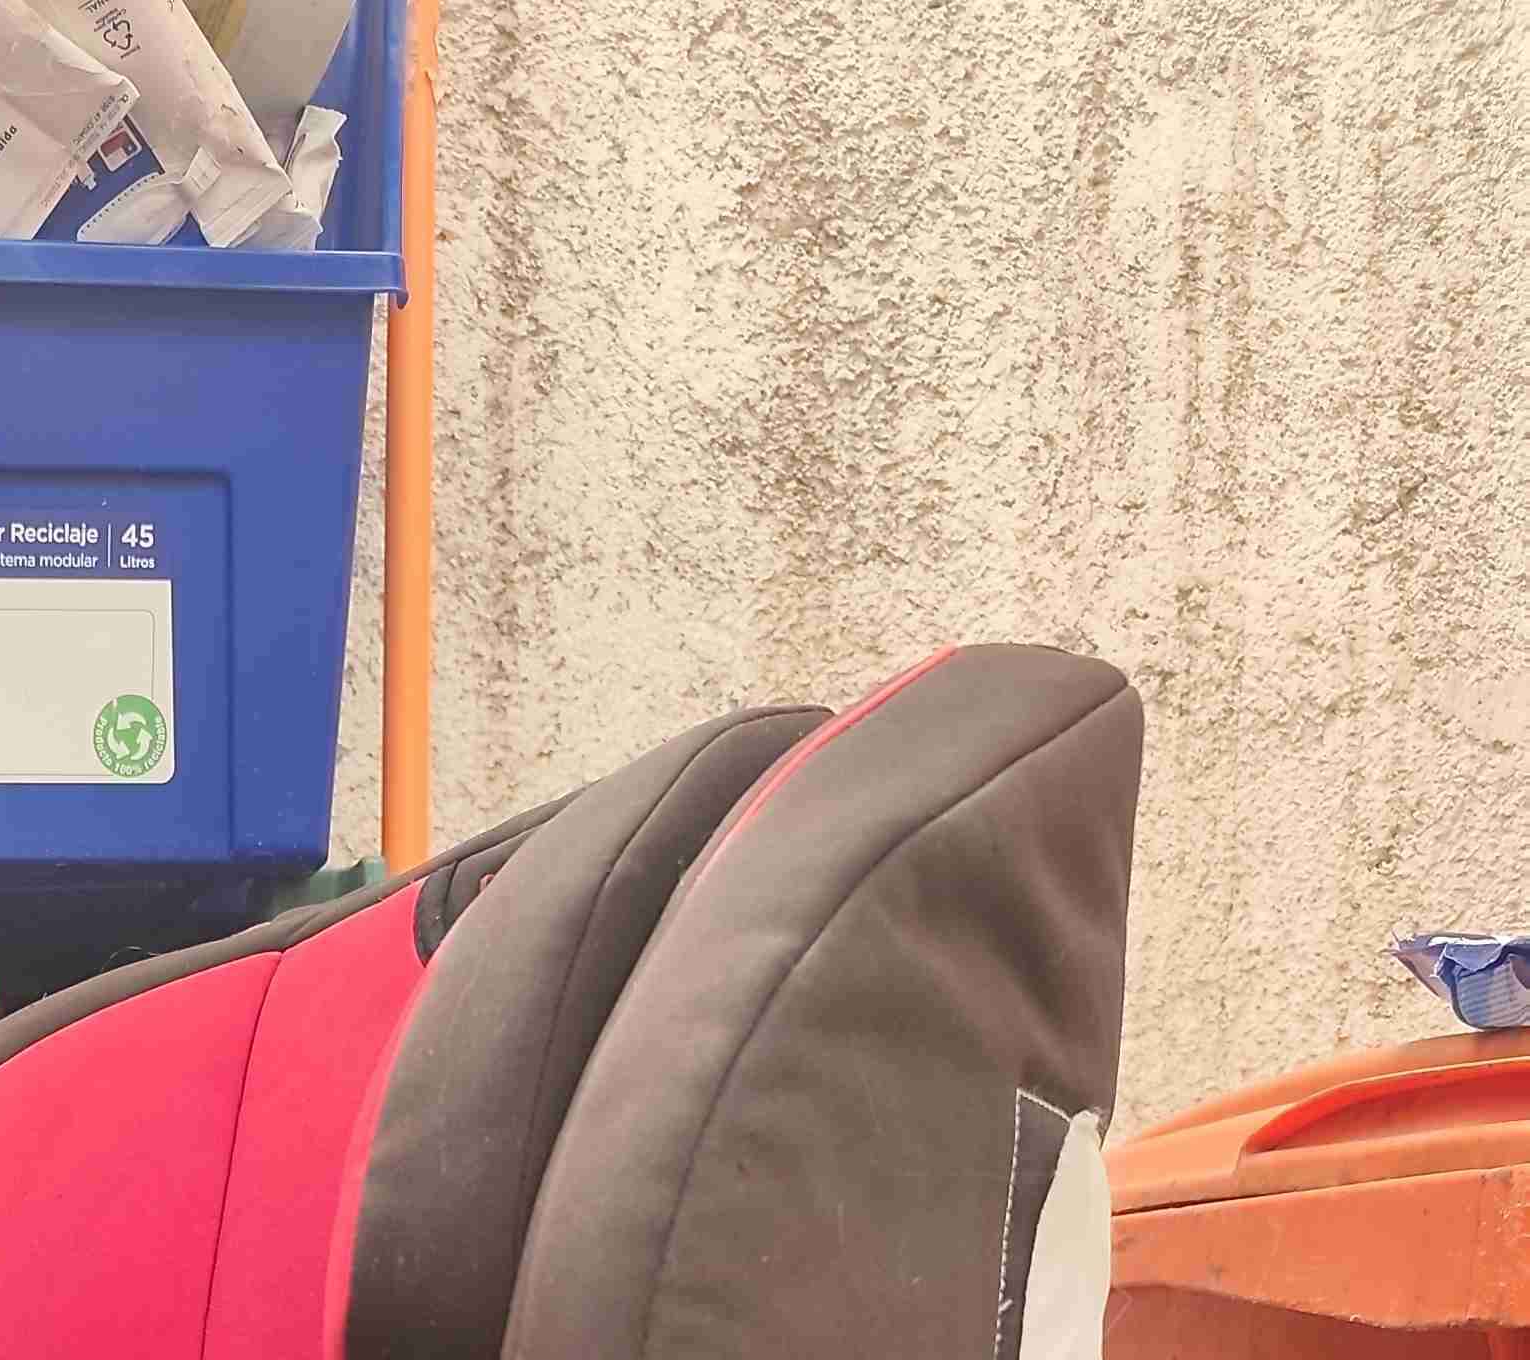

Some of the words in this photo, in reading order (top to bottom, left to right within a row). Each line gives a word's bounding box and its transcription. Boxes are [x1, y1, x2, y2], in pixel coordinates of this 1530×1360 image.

[10, 522, 99, 547] Reciclaje
[120, 524, 154, 548] 45
[39, 553, 98, 568] modular
[120, 555, 155, 569] Litros
